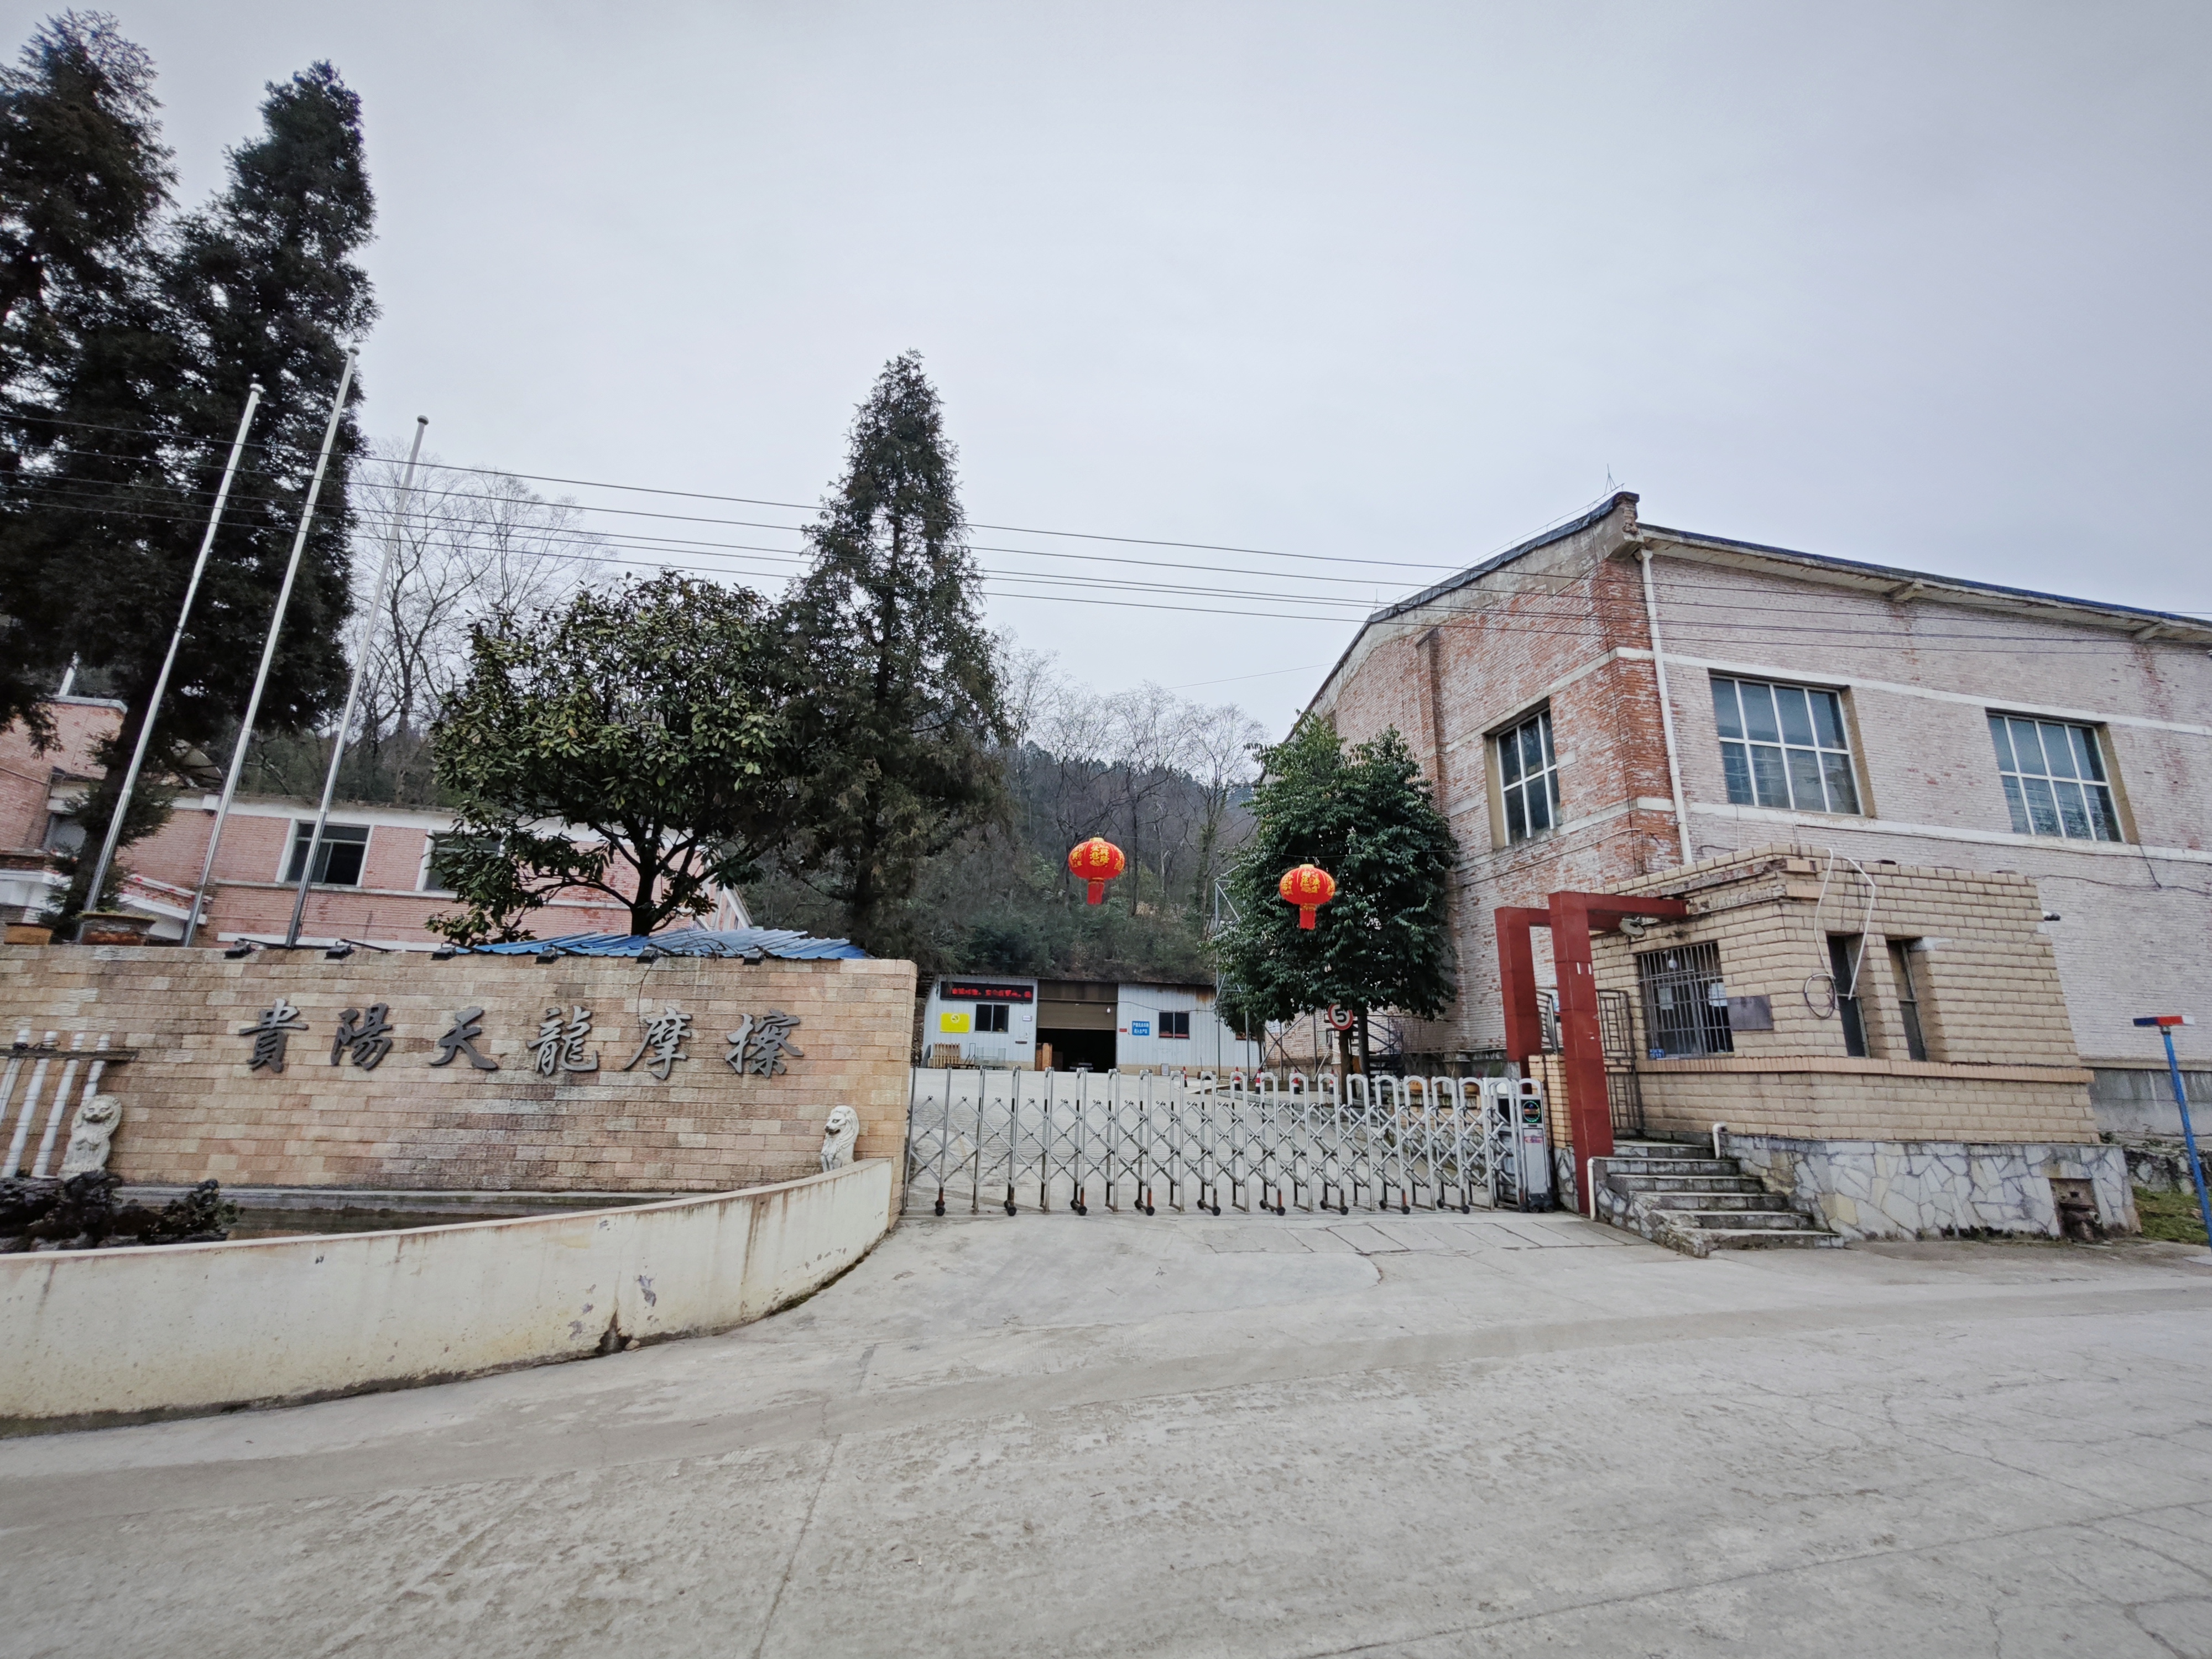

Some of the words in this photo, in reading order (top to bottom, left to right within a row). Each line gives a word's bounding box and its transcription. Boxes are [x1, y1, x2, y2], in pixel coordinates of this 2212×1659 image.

[238, 998, 805, 1079] 貴陽天龍摩擦
[1334, 1008, 1347, 1023] 5
